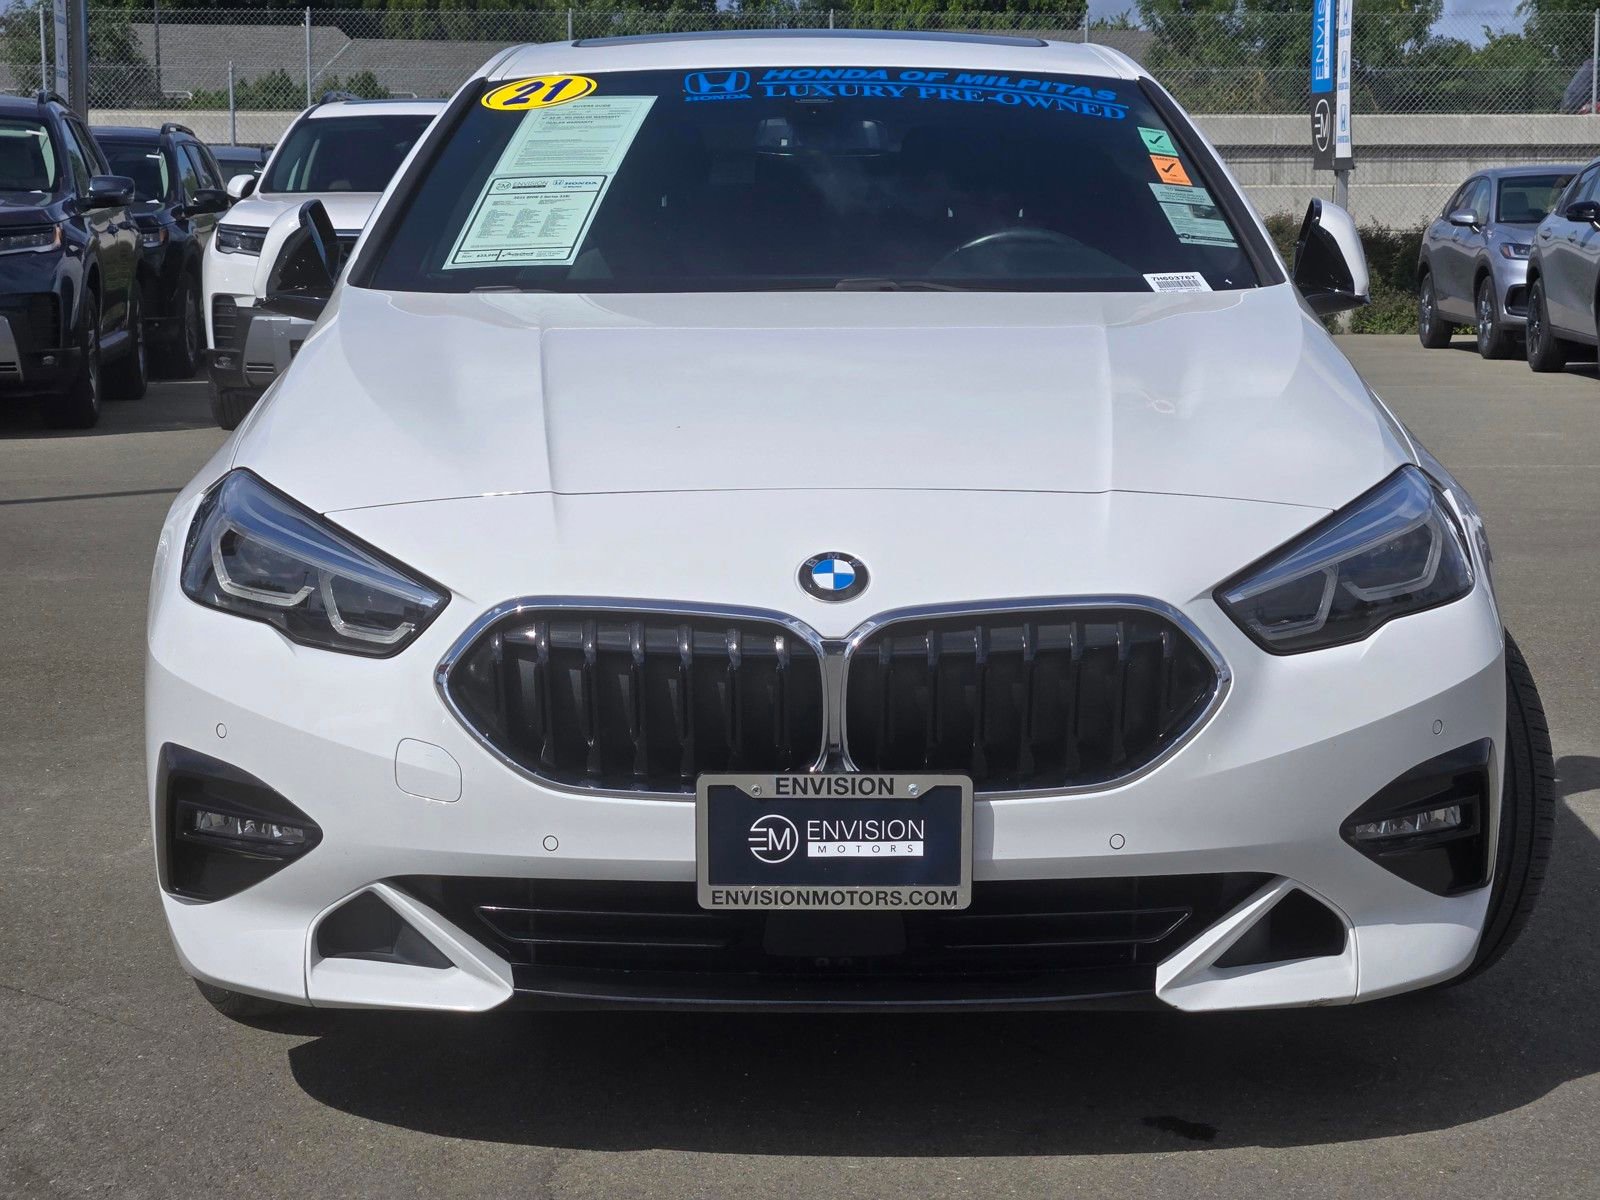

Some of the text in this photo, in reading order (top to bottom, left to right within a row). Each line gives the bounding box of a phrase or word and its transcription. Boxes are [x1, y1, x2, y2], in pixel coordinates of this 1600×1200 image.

[503, 79, 573, 105] 21
[762, 69, 1117, 101] HONDA OF MILPITAS
[764, 85, 1126, 120] LUXURY PRE-OWNED
[775, 777, 894, 796] ENVISION
[807, 819, 925, 840] ENVISION
[817, 844, 914, 854] MOTORS
[711, 890, 958, 906] ENVISIONMOTORS.COM
